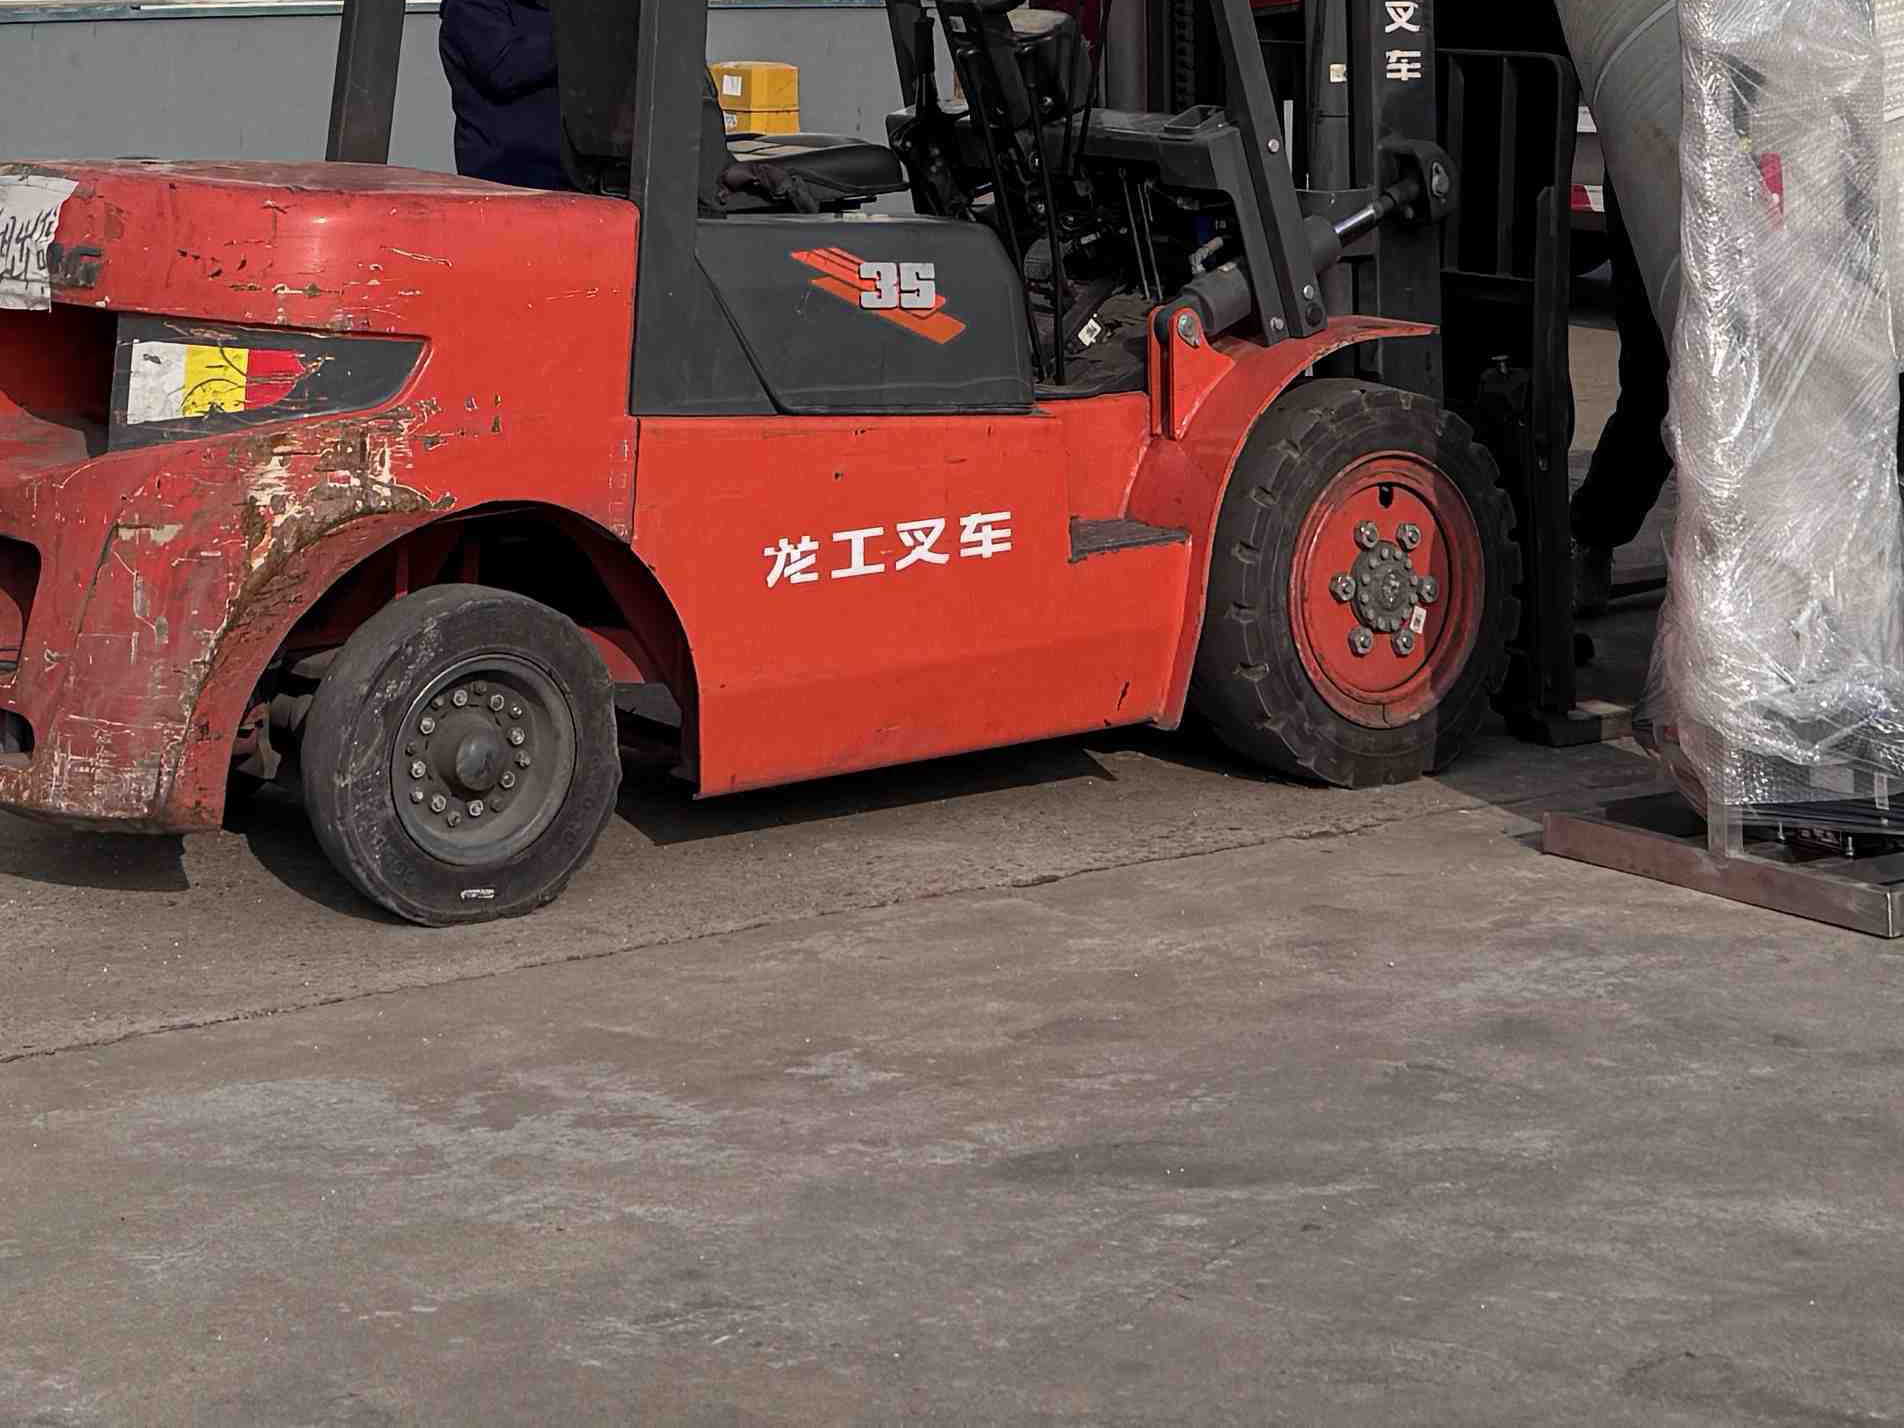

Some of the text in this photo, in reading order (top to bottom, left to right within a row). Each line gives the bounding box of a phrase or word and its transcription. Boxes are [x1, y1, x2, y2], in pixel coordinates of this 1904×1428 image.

[858, 261, 936, 310] 35
[763, 511, 1014, 589] 龙工叉车
